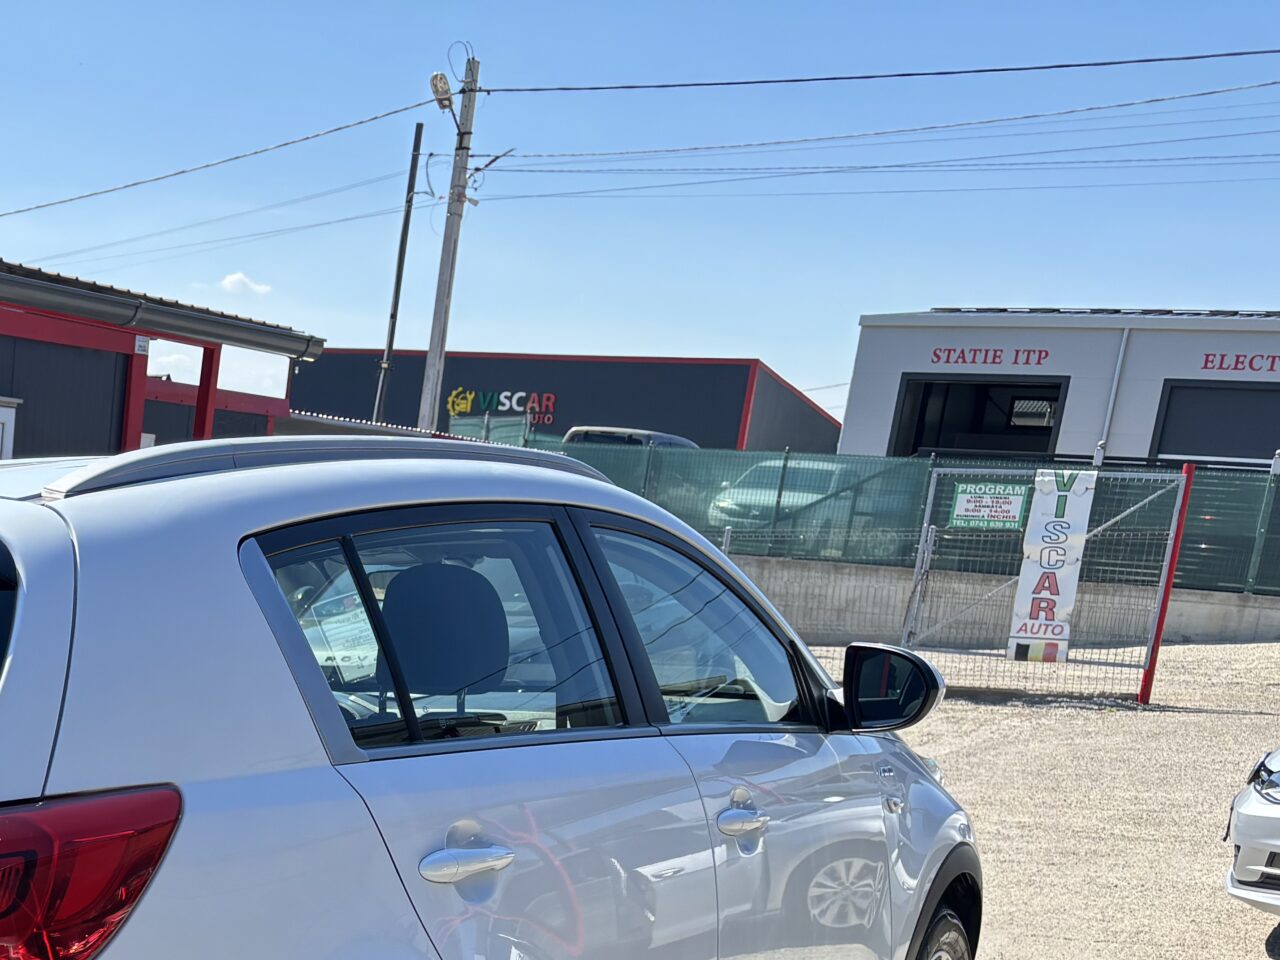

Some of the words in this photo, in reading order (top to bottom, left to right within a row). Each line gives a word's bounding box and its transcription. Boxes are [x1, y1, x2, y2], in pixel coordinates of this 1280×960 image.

[931, 347, 1003, 365] STATIE
[1012, 348, 1049, 366] ITP
[479, 391, 557, 413] VISCAR
[530, 414, 554, 425] UTO
[957, 483, 1026, 495] PROGRAM
[1016, 622, 1065, 637] AUTO
